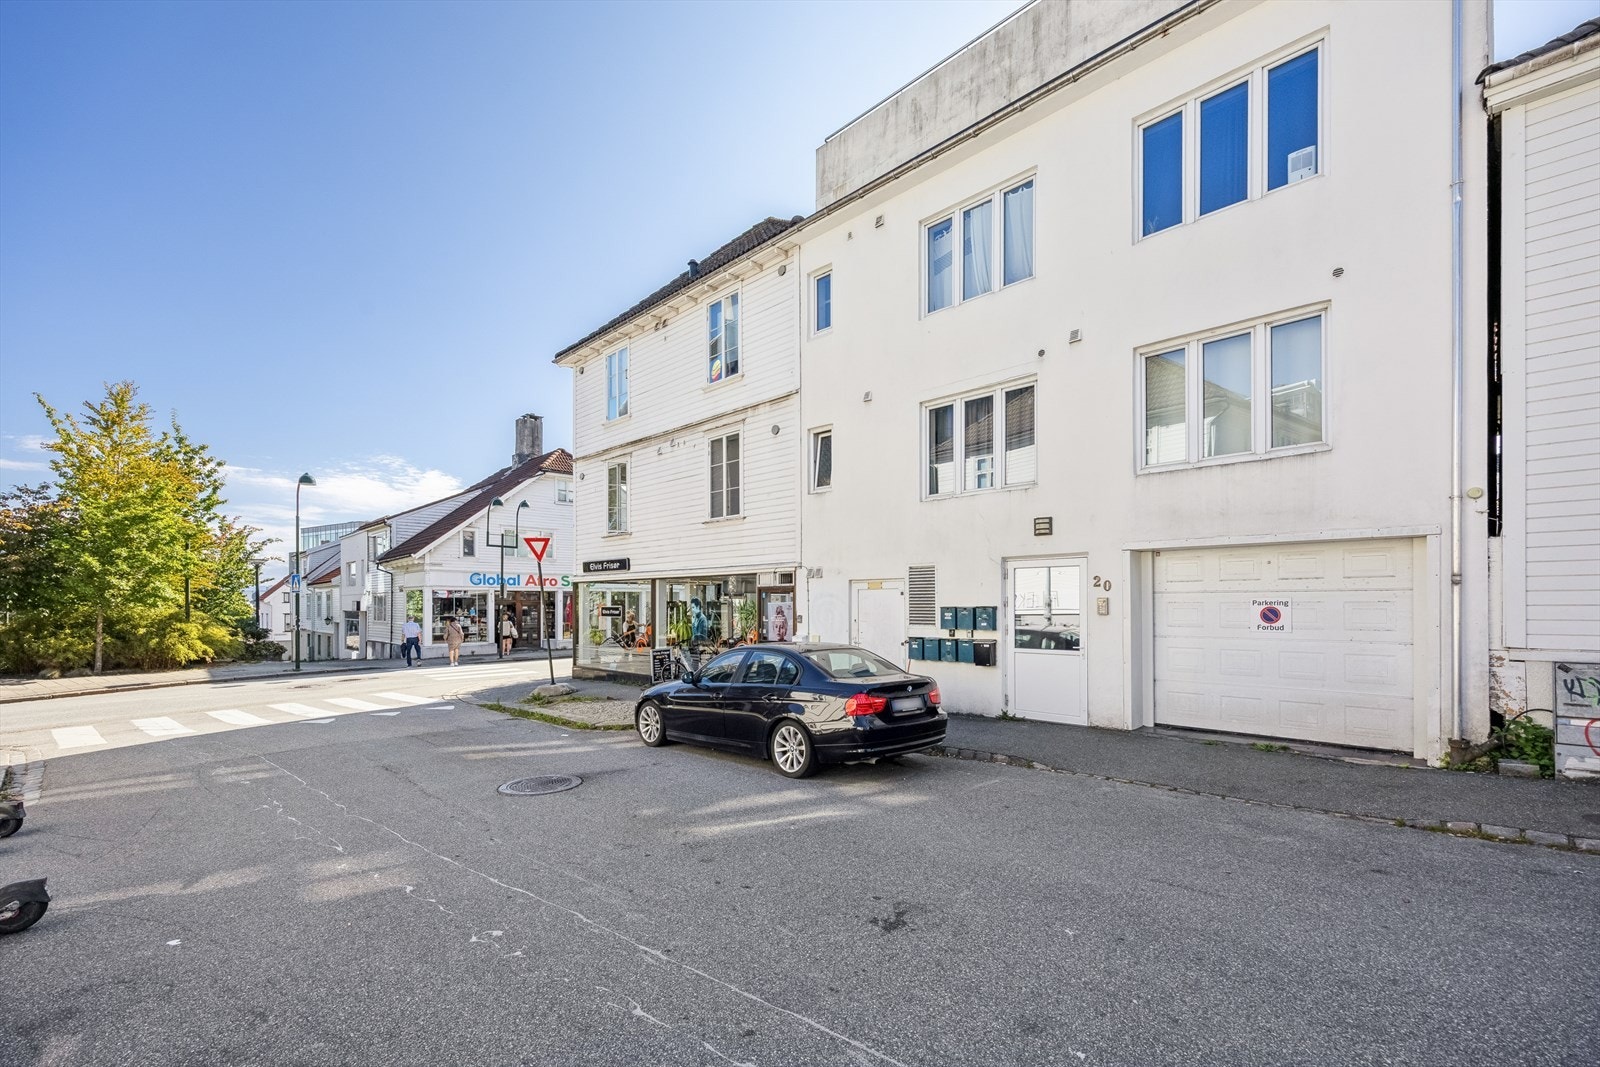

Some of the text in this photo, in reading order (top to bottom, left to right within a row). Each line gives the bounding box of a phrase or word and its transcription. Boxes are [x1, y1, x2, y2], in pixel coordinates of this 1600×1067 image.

[590, 563, 602, 571] Elvis
[469, 572, 520, 586] Global
[561, 575, 573, 587] S
[1093, 575, 1112, 592] 20
[1252, 599, 1289, 608] Parkering
